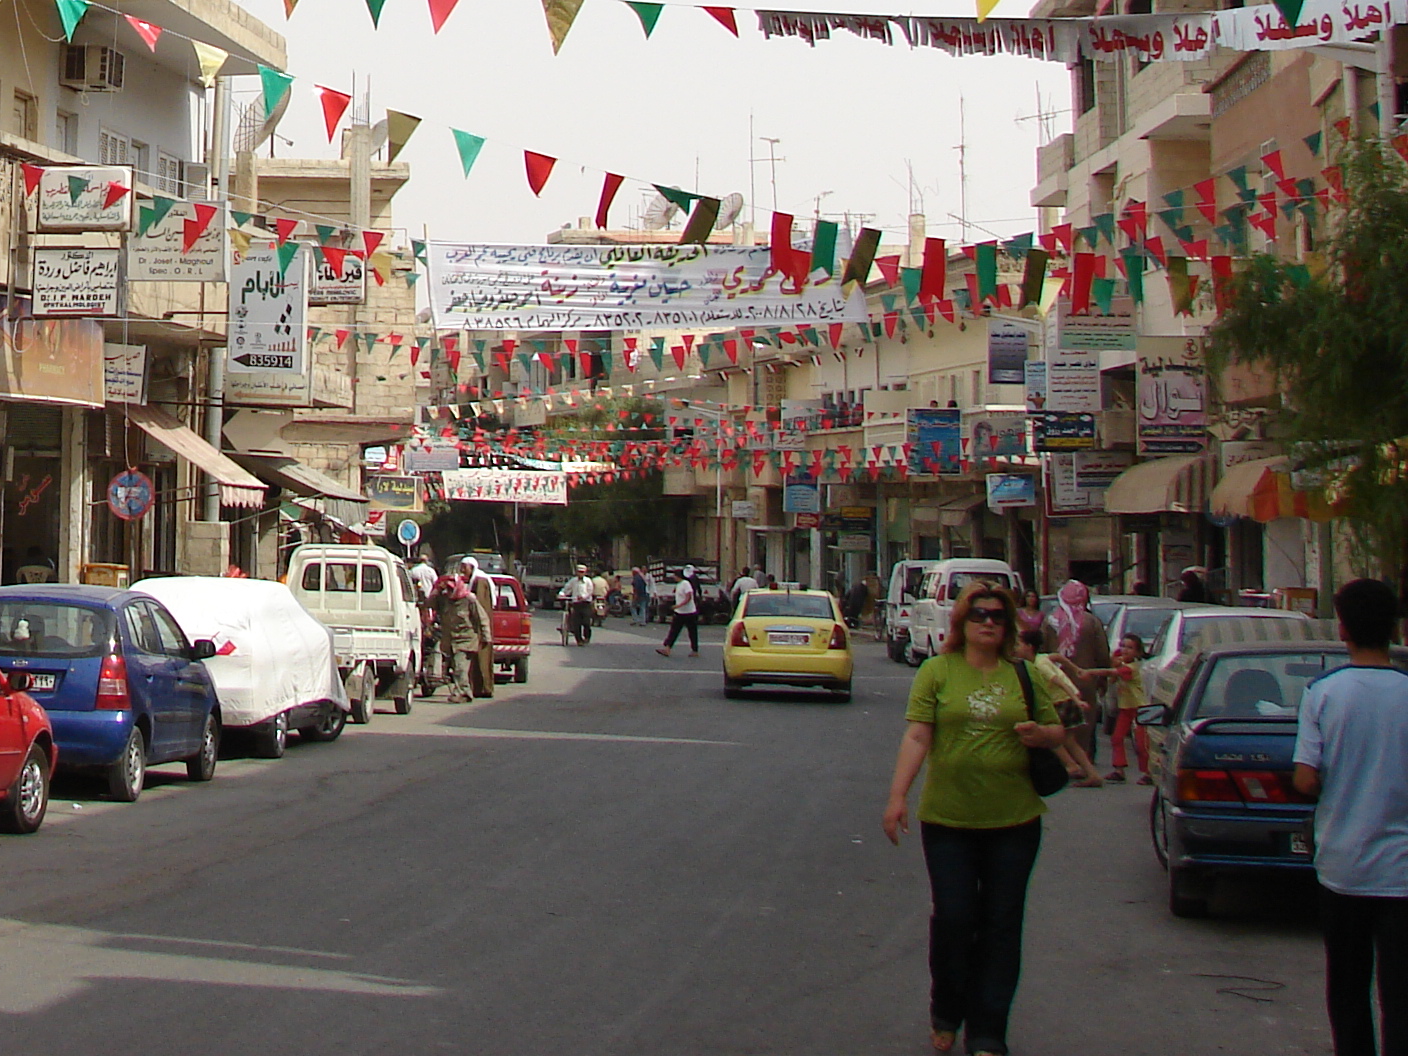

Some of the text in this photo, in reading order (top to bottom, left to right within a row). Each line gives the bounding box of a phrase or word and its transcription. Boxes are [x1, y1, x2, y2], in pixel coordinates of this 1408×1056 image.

[61, 251, 94, 261] الدكتور
[38, 260, 61, 278] وردة
[62, 260, 90, 279] فاضل
[242, 269, 285, 304] الأيام
[249, 355, 292, 367] 835914
